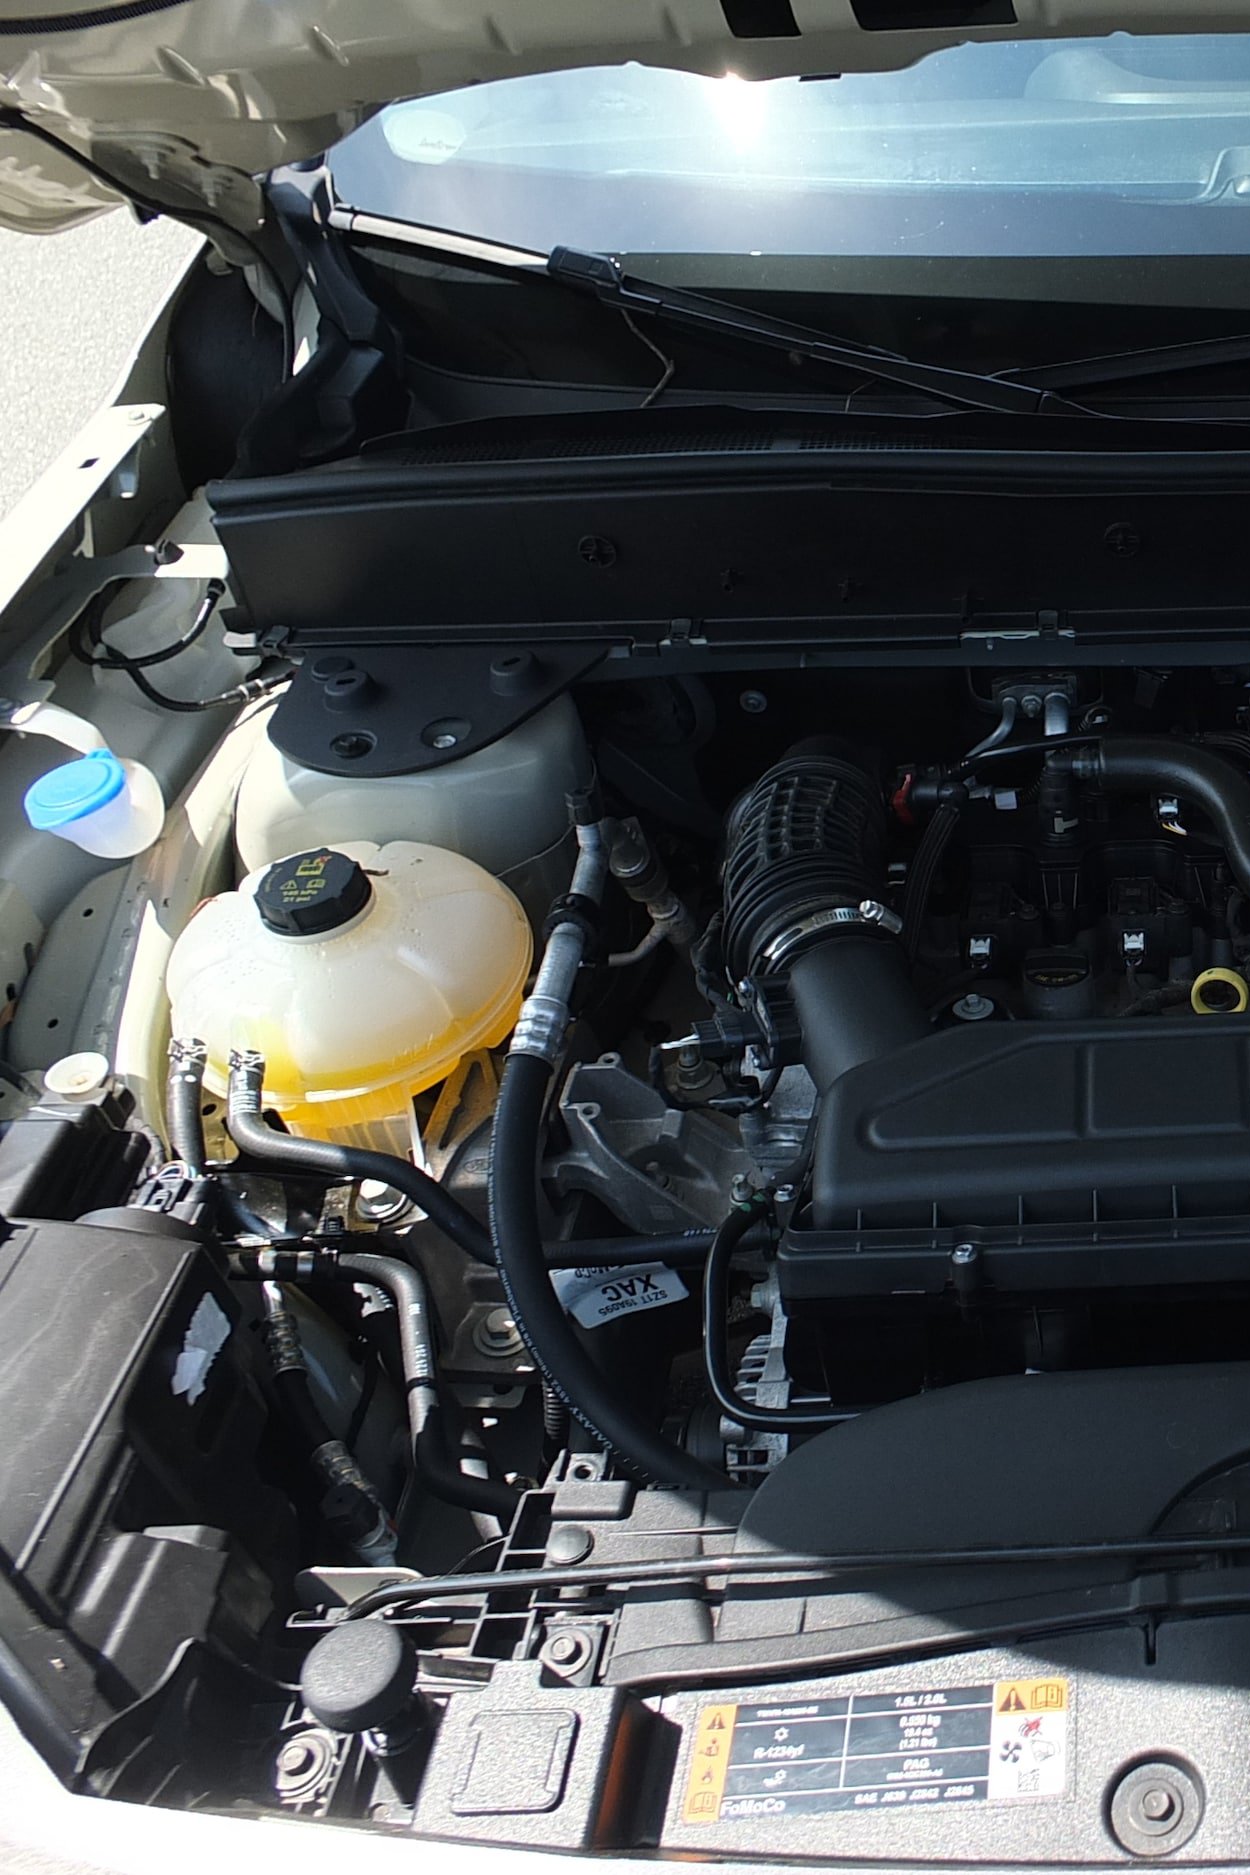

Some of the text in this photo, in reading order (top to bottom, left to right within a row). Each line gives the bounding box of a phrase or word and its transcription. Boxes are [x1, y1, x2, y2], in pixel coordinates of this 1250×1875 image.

[601, 1273, 658, 1302] XAC
[753, 1743, 805, 1760] R-1234yf
[903, 1757, 930, 1770] PAG
[720, 1798, 786, 1815] FoMoCo
[854, 1793, 878, 1804] SAE
